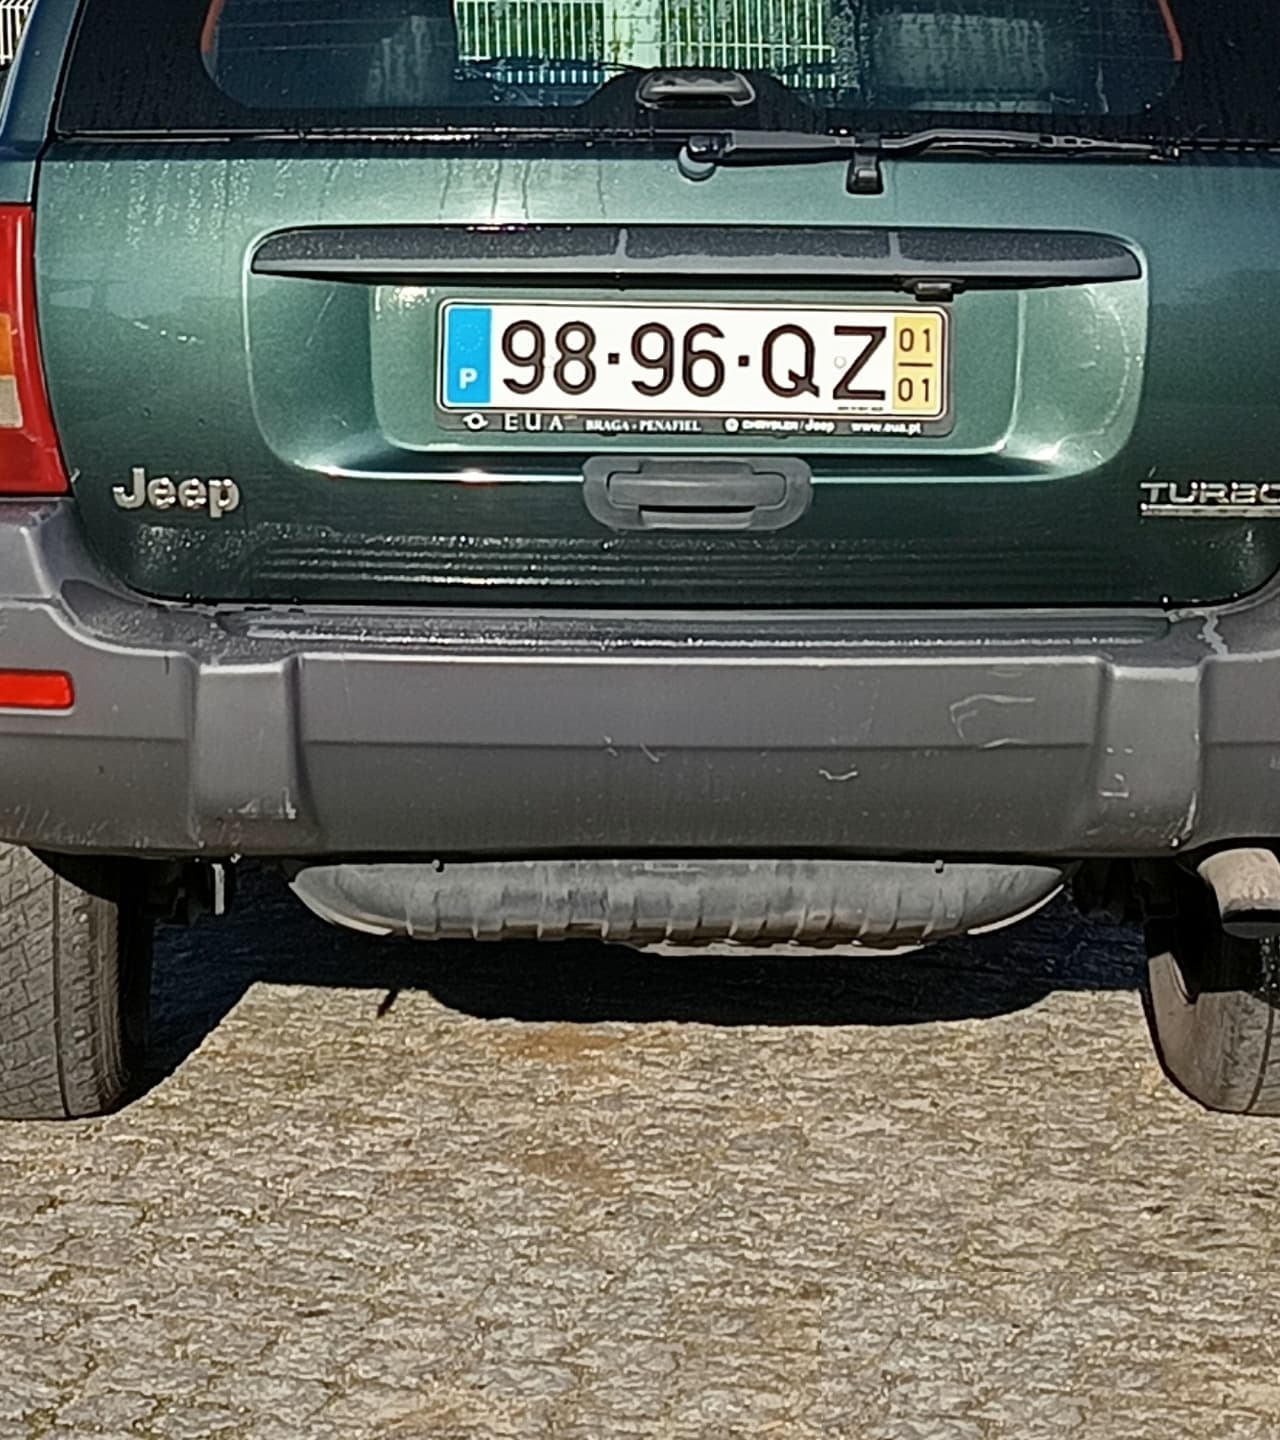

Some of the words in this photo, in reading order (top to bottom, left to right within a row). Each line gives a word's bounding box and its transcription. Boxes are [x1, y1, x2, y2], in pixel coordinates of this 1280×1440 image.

[899, 327, 931, 353] 01
[459, 367, 478, 390] P
[897, 377, 930, 403] 01
[504, 413, 564, 431] EUA
[585, 419, 628, 432] BRAGA
[639, 419, 702, 433] PENAFIEL
[112, 467, 240, 518] Jeep
